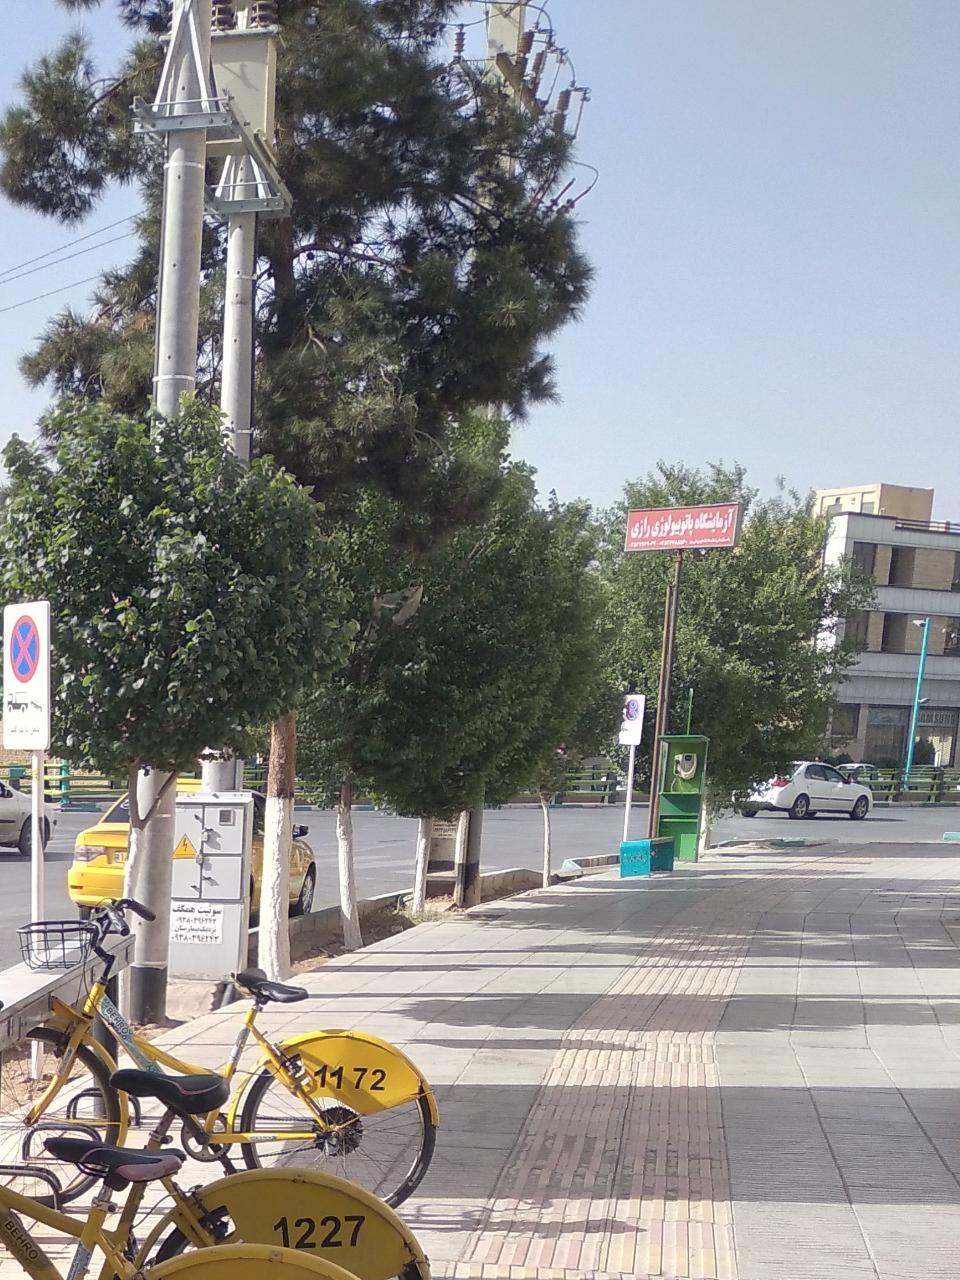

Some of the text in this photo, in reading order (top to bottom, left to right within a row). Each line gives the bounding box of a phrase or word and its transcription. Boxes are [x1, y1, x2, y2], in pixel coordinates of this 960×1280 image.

[630, 508, 735, 539] آزمایشگاه پاتوبیولوژی رازی
[105, 1007, 130, 1034] BEHRO
[314, 1064, 386, 1091] 1172
[4, 1220, 39, 1260] BEHRO
[273, 1215, 366, 1249] 1227
